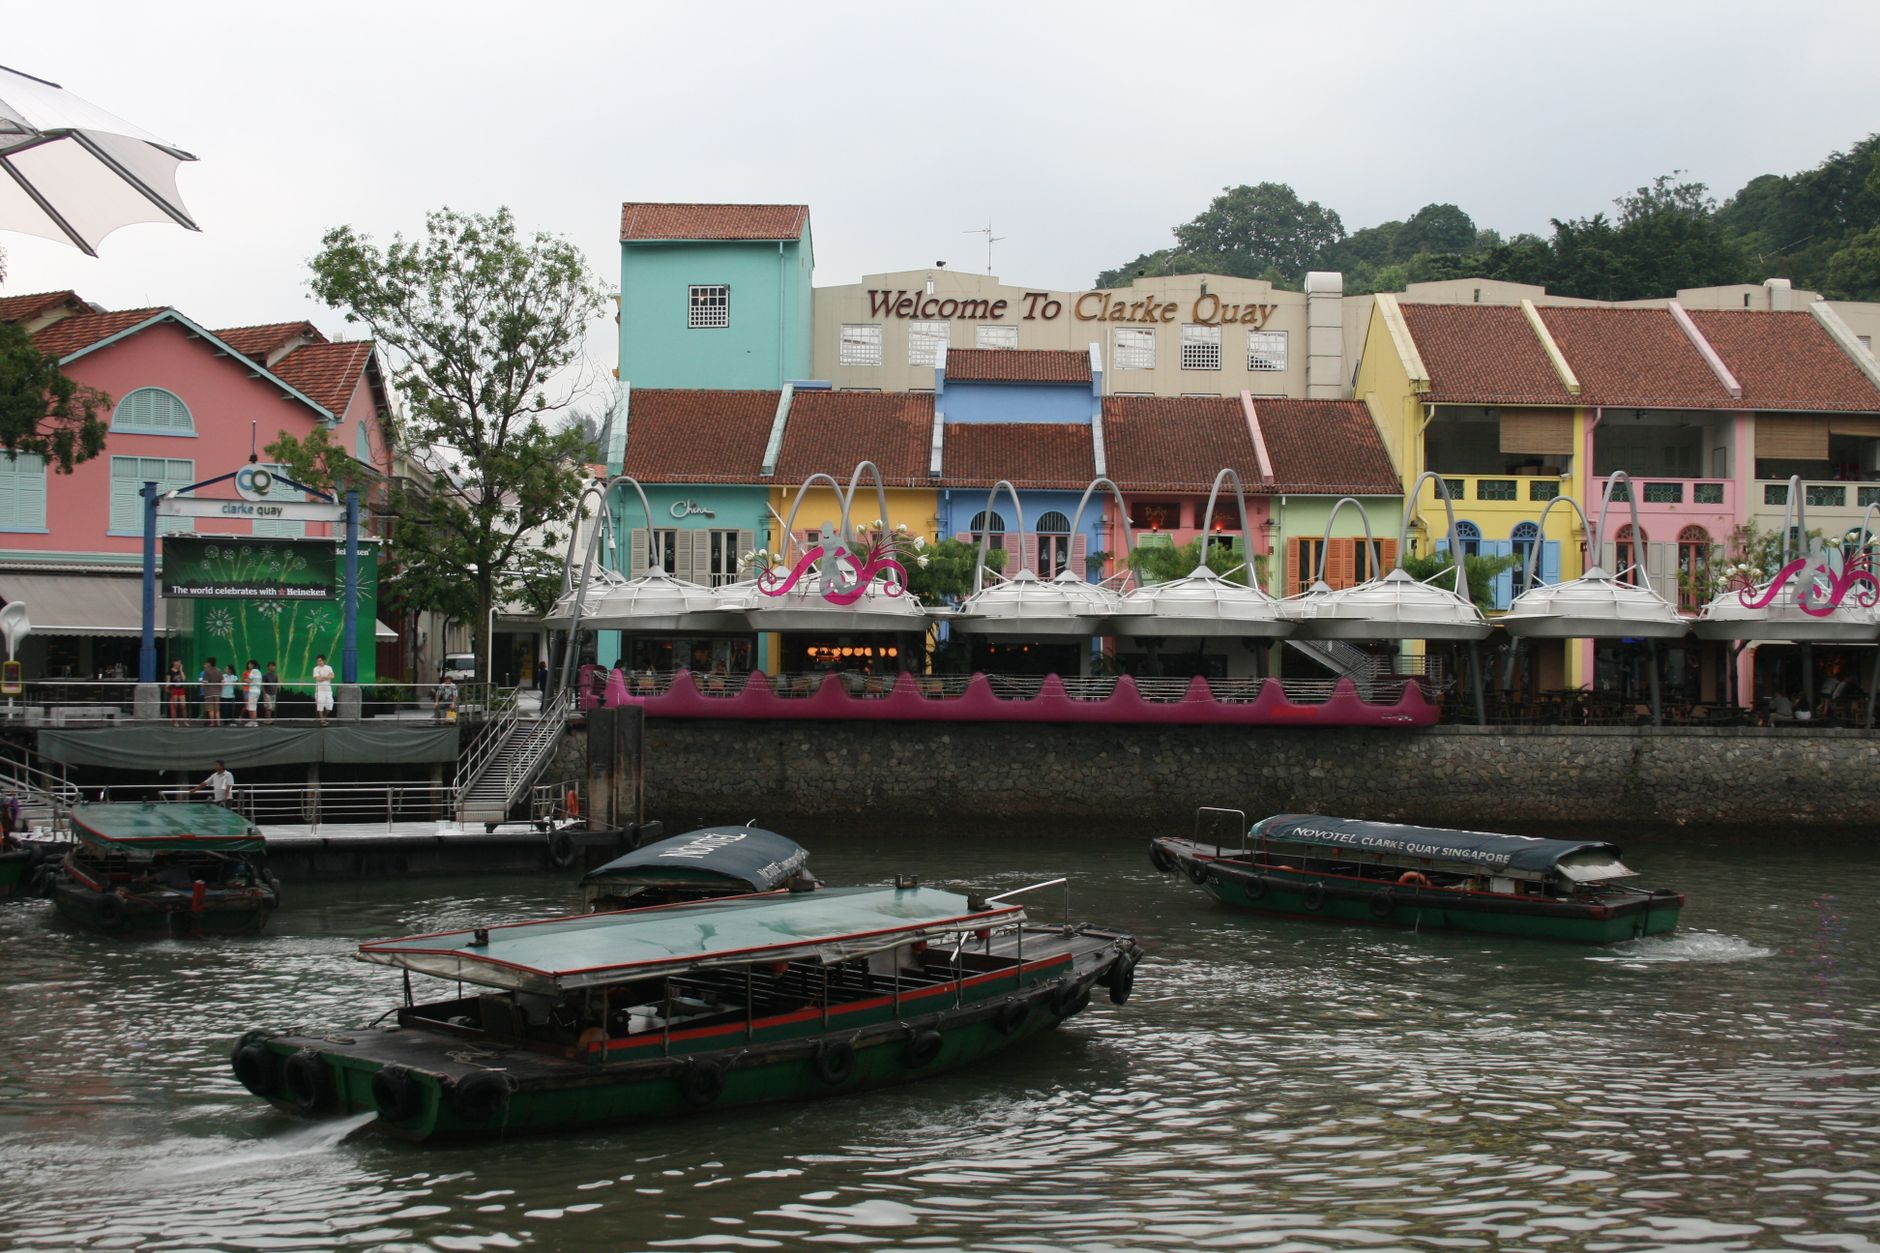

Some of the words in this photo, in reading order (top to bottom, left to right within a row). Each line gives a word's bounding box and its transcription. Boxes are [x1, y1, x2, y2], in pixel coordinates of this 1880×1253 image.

[867, 289, 1008, 320] Welcome
[1023, 292, 1062, 321] To
[1074, 292, 1178, 323] Clarke
[1192, 293, 1279, 331] Quay
[222, 503, 254, 515] clarke
[256, 505, 283, 518] quay
[172, 585, 188, 595] The
[190, 586, 213, 595] world
[215, 586, 258, 596] celebrates
[259, 587, 277, 596] with
[286, 587, 326, 597] Heineken
[1291, 827, 1358, 844] NOVOTEL
[1361, 837, 1405, 850] CLARKE
[1406, 842, 1440, 855] QUAY
[1441, 847, 1511, 864] SINGAPORE
